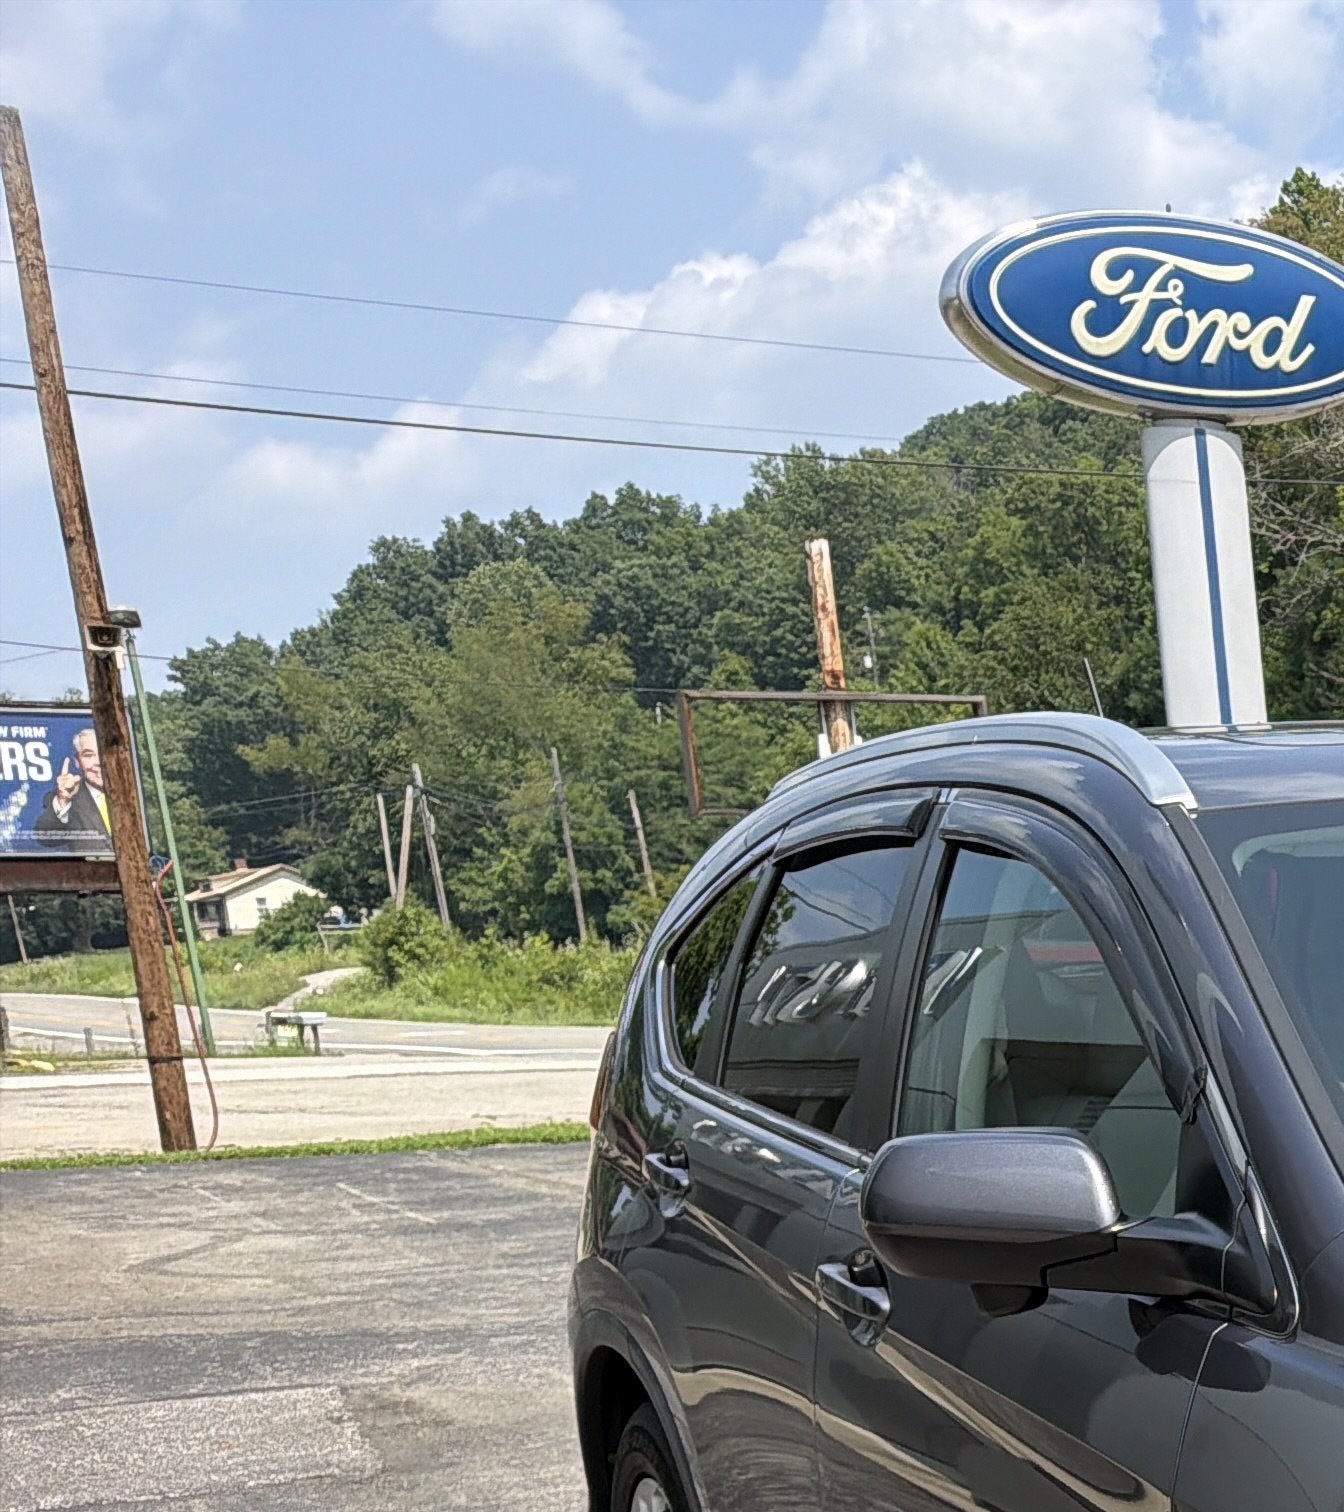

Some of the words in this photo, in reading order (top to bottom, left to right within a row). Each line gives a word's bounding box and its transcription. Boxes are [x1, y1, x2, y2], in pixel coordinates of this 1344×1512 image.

[1071, 246, 1316, 373] Ford
[11, 726, 46, 738] FIRM
[0, 741, 52, 781] RS
